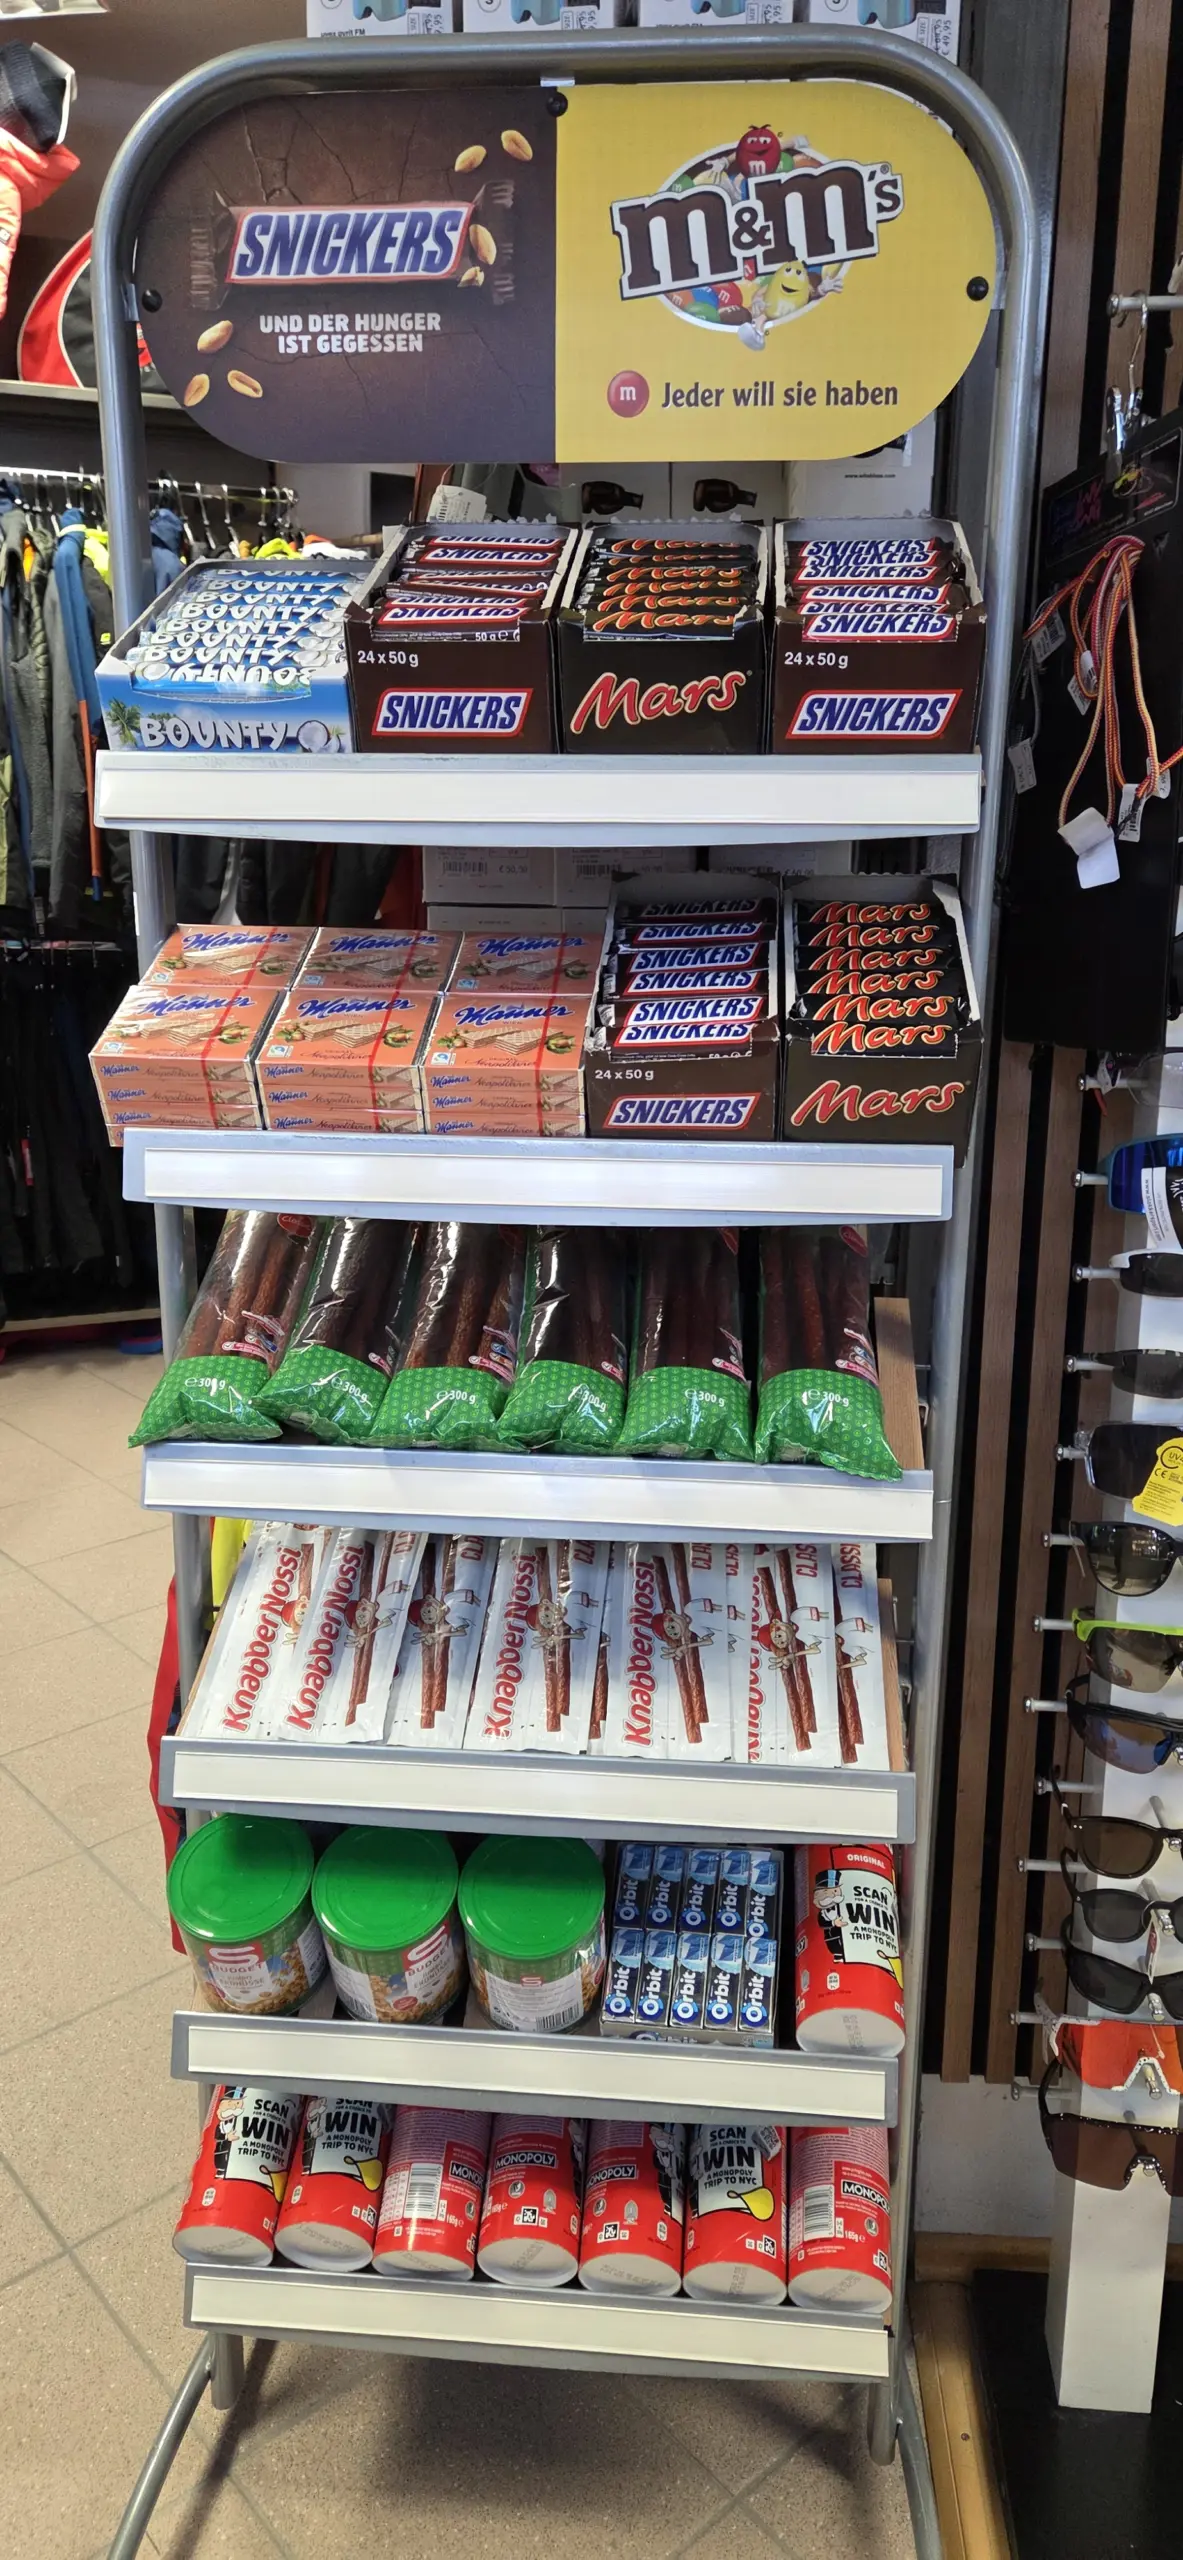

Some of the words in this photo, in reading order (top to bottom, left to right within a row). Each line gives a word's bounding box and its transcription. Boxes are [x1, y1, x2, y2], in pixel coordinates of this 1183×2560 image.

[235, 210, 463, 277] SNICKERS
[260, 315, 303, 333] UND
[308, 314, 349, 332] DER
[355, 313, 441, 332] HUNGER
[278, 334, 312, 354] IST
[316, 333, 424, 353] GEGESSEN
[620, 386, 636, 401] m
[661, 382, 725, 409] Jeder
[732, 382, 775, 407] will
[783, 382, 817, 407] sie
[825, 381, 899, 406] haben
[807, 540, 933, 557] SNICKERS
[207, 581, 338, 594] BOUNTY
[812, 585, 940, 601] SNICKERS
[195, 591, 331, 606] BOUNTY
[597, 594, 739, 612] Mars
[182, 602, 321, 621] BOUNTY
[592, 611, 736, 632] Mars
[166, 619, 308, 636] BOUNTY
[814, 613, 949, 635] SNICKERS
[151, 631, 298, 651] BOUNTY
[475, 631, 487, 642] 50
[143, 644, 294, 667] BOUNTY
[357, 650, 375, 664] 24
[378, 653, 387, 665] x
[388, 651, 407, 665] 50
[409, 653, 419, 668] g
[784, 652, 802, 665] 24
[805, 655, 815, 665] x
[817, 653, 836, 665] 50
[838, 655, 849, 669] g
[381, 695, 523, 730] SNICKERS
[570, 671, 746, 735] Mars
[797, 697, 950, 732] SNICKERS
[139, 716, 288, 750] BOUNTY
[809, 901, 932, 923] Mars
[183, 931, 291, 951] Manner
[643, 922, 760, 939] SNICKERS
[808, 923, 940, 946] Mars
[329, 933, 441, 954] Manner
[478, 936, 588, 957] Manner
[636, 943, 755, 970] SNICKERS
[808, 946, 945, 970] Mars
[636, 971, 755, 991] SNICKERS
[807, 970, 945, 995] Mars
[138, 993, 257, 1017] Manner
[297, 996, 417, 1020] Manner
[454, 1004, 575, 1027] Manner
[633, 997, 757, 1023] SNICKERS
[812, 994, 955, 1022] Mars
[625, 1023, 752, 1042] SNICKERS
[811, 1021, 953, 1054] Mars
[101, 1063, 140, 1078] Manner
[264, 1066, 305, 1079] Manner
[594, 1069, 612, 1080] 24
[614, 1071, 623, 1080] x
[625, 1069, 643, 1080] 50
[644, 1070, 655, 1081] g
[430, 1075, 472, 1088] Manner
[108, 1089, 147, 1102] Manner
[268, 1090, 308, 1103] Manner
[432, 1096, 472, 1109] Manner
[790, 1078, 966, 1127] Mars
[113, 1111, 152, 1125] Manner
[612, 1098, 751, 1125] SNICKERS
[274, 1117, 314, 1129] Manner
[434, 1121, 475, 1133] Manner
[449, 1390, 468, 1402] 300
[468, 1394, 476, 1405] g
[582, 1391, 600, 1407] 300
[599, 1402, 607, 1413] g
[698, 1391, 717, 1404] 300
[717, 1396, 725, 1408] g
[822, 1391, 841, 1403] 300
[841, 1396, 850, 1408] g
[223, 1544, 303, 1734] KnabberNossi
[286, 1544, 365, 1733] KnabberNossi
[484, 1553, 538, 1738] KnabberNossi
[624, 1561, 657, 1747] KnabberNossi
[846, 1853, 886, 1870] ORIGINAL
[620, 1879, 638, 1921] Orbit
[652, 1880, 671, 1923] Orbit
[685, 1883, 704, 1926] Orbit
[720, 1885, 738, 1927] Orbit
[853, 1885, 890, 1906] SCAN
[748, 1894, 767, 1938] Orbit
[846, 1902, 896, 1937] WIN
[849, 1932, 872, 1941] TRIP
[874, 1936, 885, 1946] TO
[861, 1927, 896, 1943] MONOPOLY
[211, 1961, 263, 1974] BUDGET
[609, 1966, 630, 2014] Orbit
[642, 1968, 663, 2017] Orbit
[676, 1970, 696, 2019] Orbit
[711, 1972, 731, 2021] Orbit
[745, 1974, 766, 2023] Orbit
[253, 2099, 290, 2118] SCAN
[241, 2116, 290, 2149] WIN
[324, 2111, 377, 2138] WIN
[709, 2126, 747, 2143] SCAN
[249, 2141, 284, 2157] MONOPOLY
[321, 2141, 343, 2150] TRIP
[344, 2142, 356, 2151] TO
[357, 2145, 374, 2156] NYC
[333, 2135, 372, 2146] MONOPOLY
[237, 2147, 260, 2158] TRIP
[260, 2151, 272, 2160] TO
[271, 2154, 285, 2168] NYC
[495, 2151, 556, 2170] MONOPOLY
[702, 2146, 756, 2171] WIN
[704, 2178, 723, 2190] TRIP
[724, 2176, 738, 2185] TO
[738, 2176, 758, 2186] NYC
[712, 2169, 754, 2178] MONOPOLY
[844, 2230, 860, 2242] 165g
